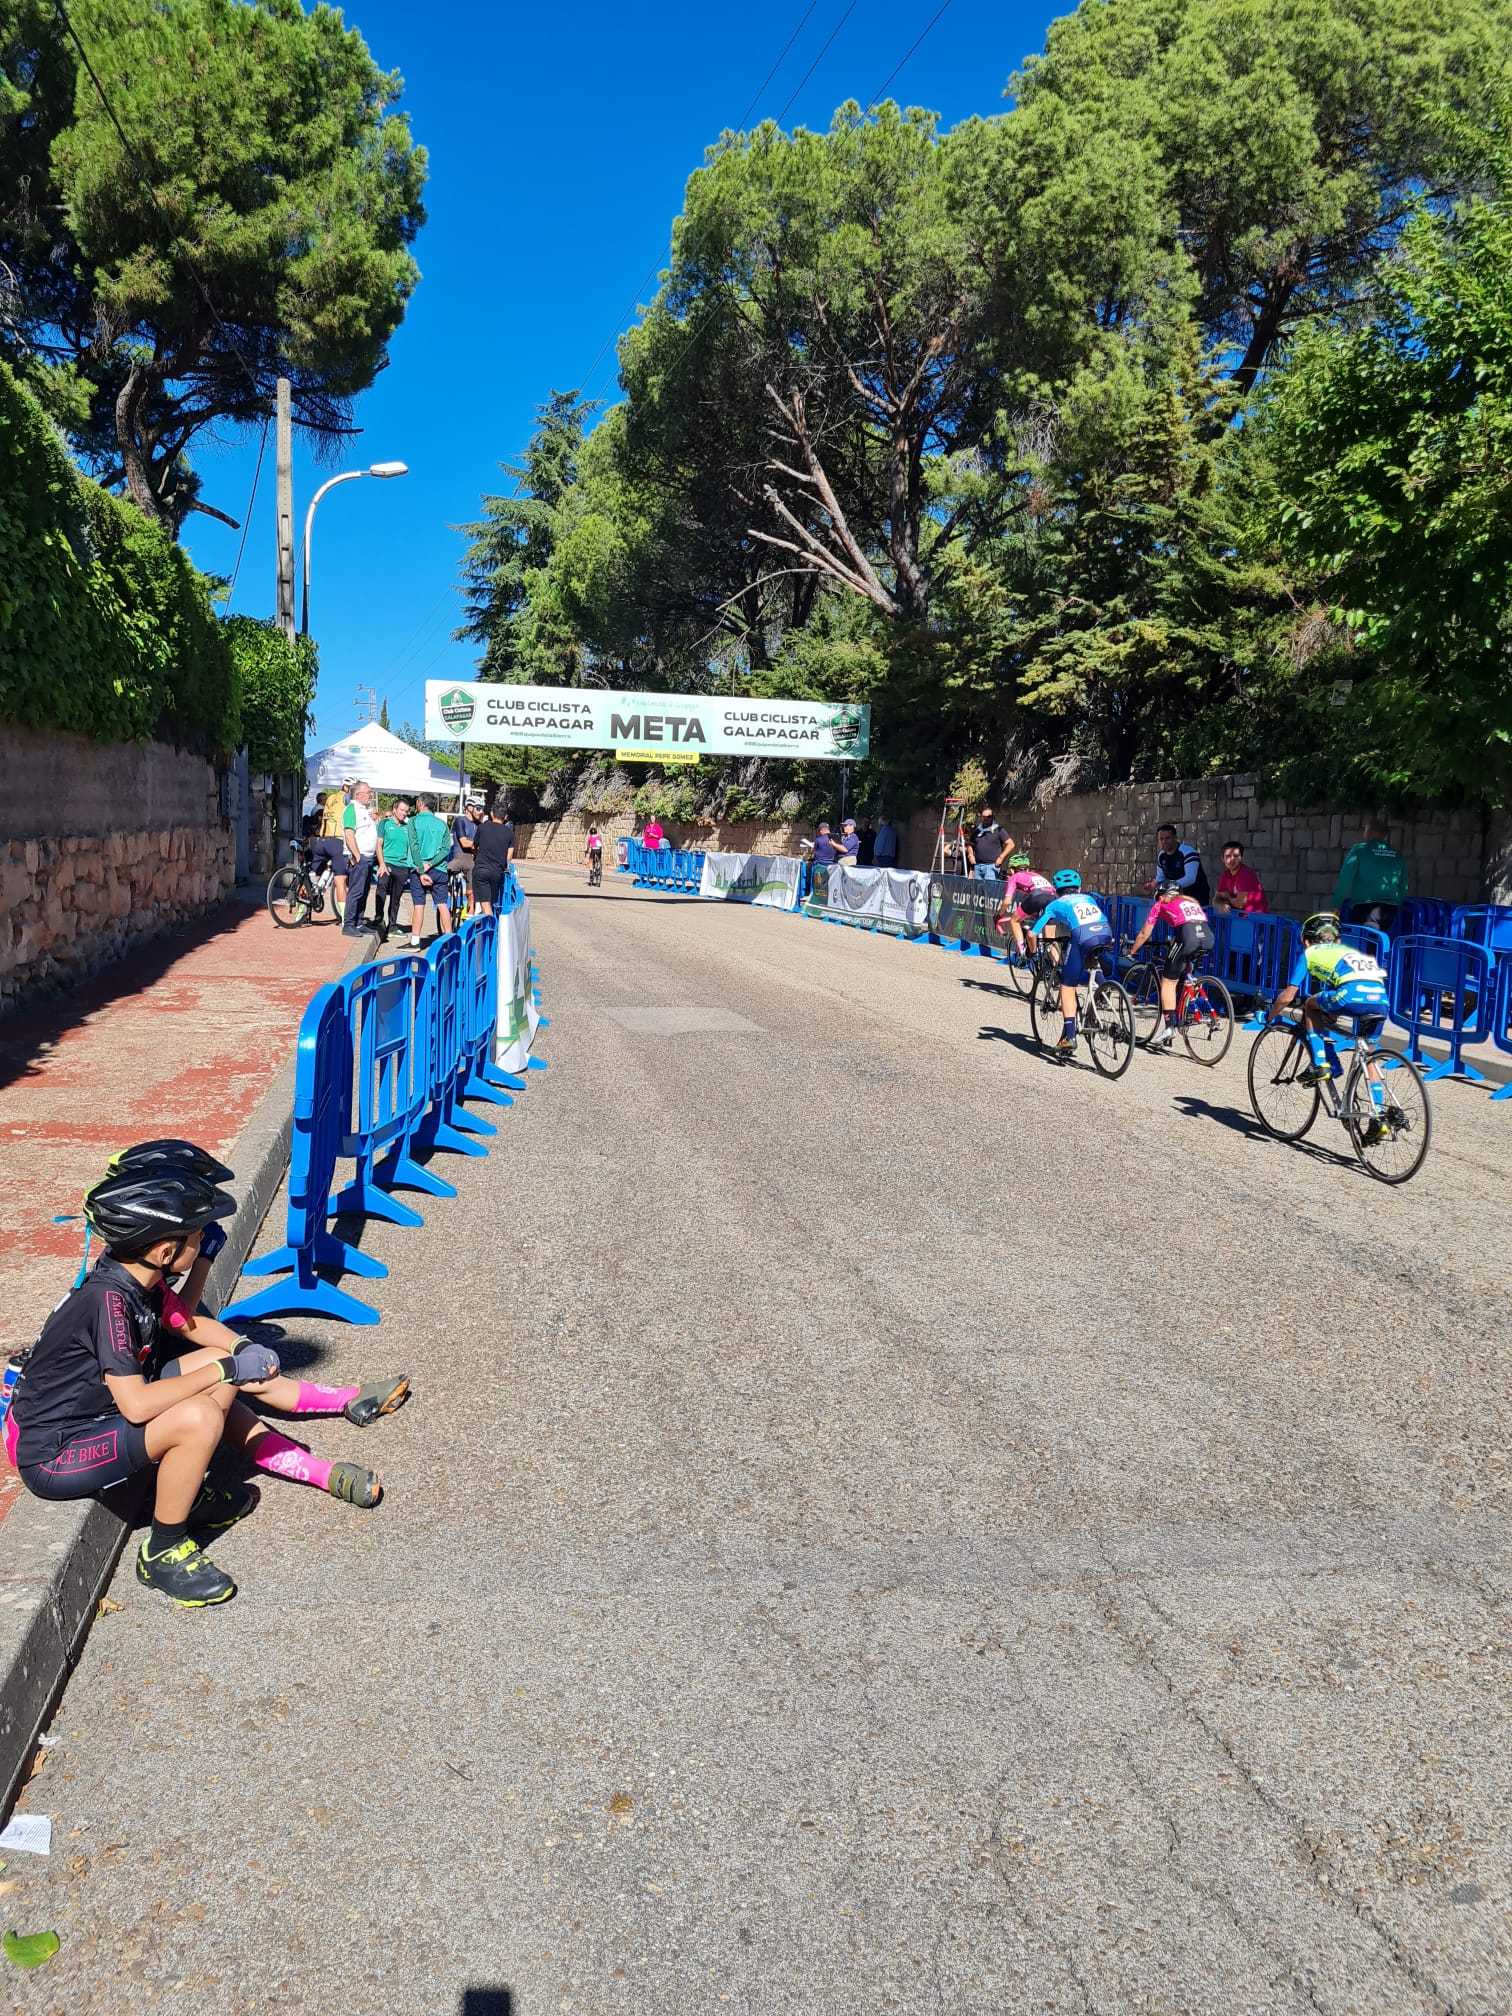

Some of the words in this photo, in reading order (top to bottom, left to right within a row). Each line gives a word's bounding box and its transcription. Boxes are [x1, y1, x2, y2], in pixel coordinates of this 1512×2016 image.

[487, 699, 525, 711] CLUB
[527, 701, 592, 714] CICLISTA
[486, 714, 594, 730] GALAPAGAR
[724, 711, 758, 722] CLUB
[760, 713, 818, 725] CICLISTA
[610, 713, 706, 743] META
[723, 726, 820, 740] GALAPAGAR
[620, 751, 653, 760] MEMORIAL
[952, 892, 971, 906] CLUB
[1077, 907, 1099, 920] 244
[111, 1294, 124, 1318] BIKE
[79, 1441, 110, 1463] BIKE
